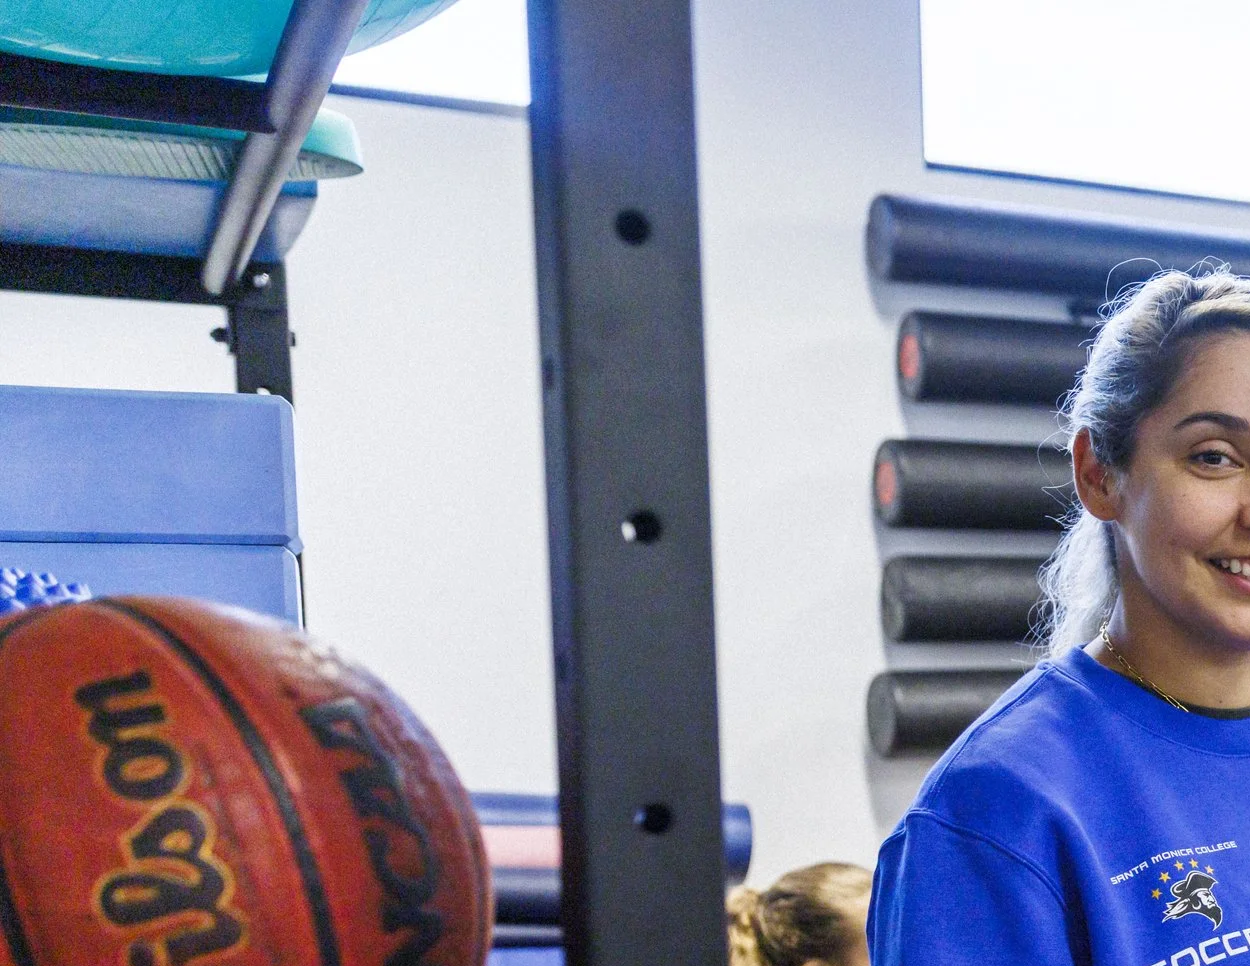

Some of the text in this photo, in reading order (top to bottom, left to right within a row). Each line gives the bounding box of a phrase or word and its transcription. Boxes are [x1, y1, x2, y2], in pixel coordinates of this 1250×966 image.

[1110, 840, 1238, 885] SANTA MONICA COLLEGE
